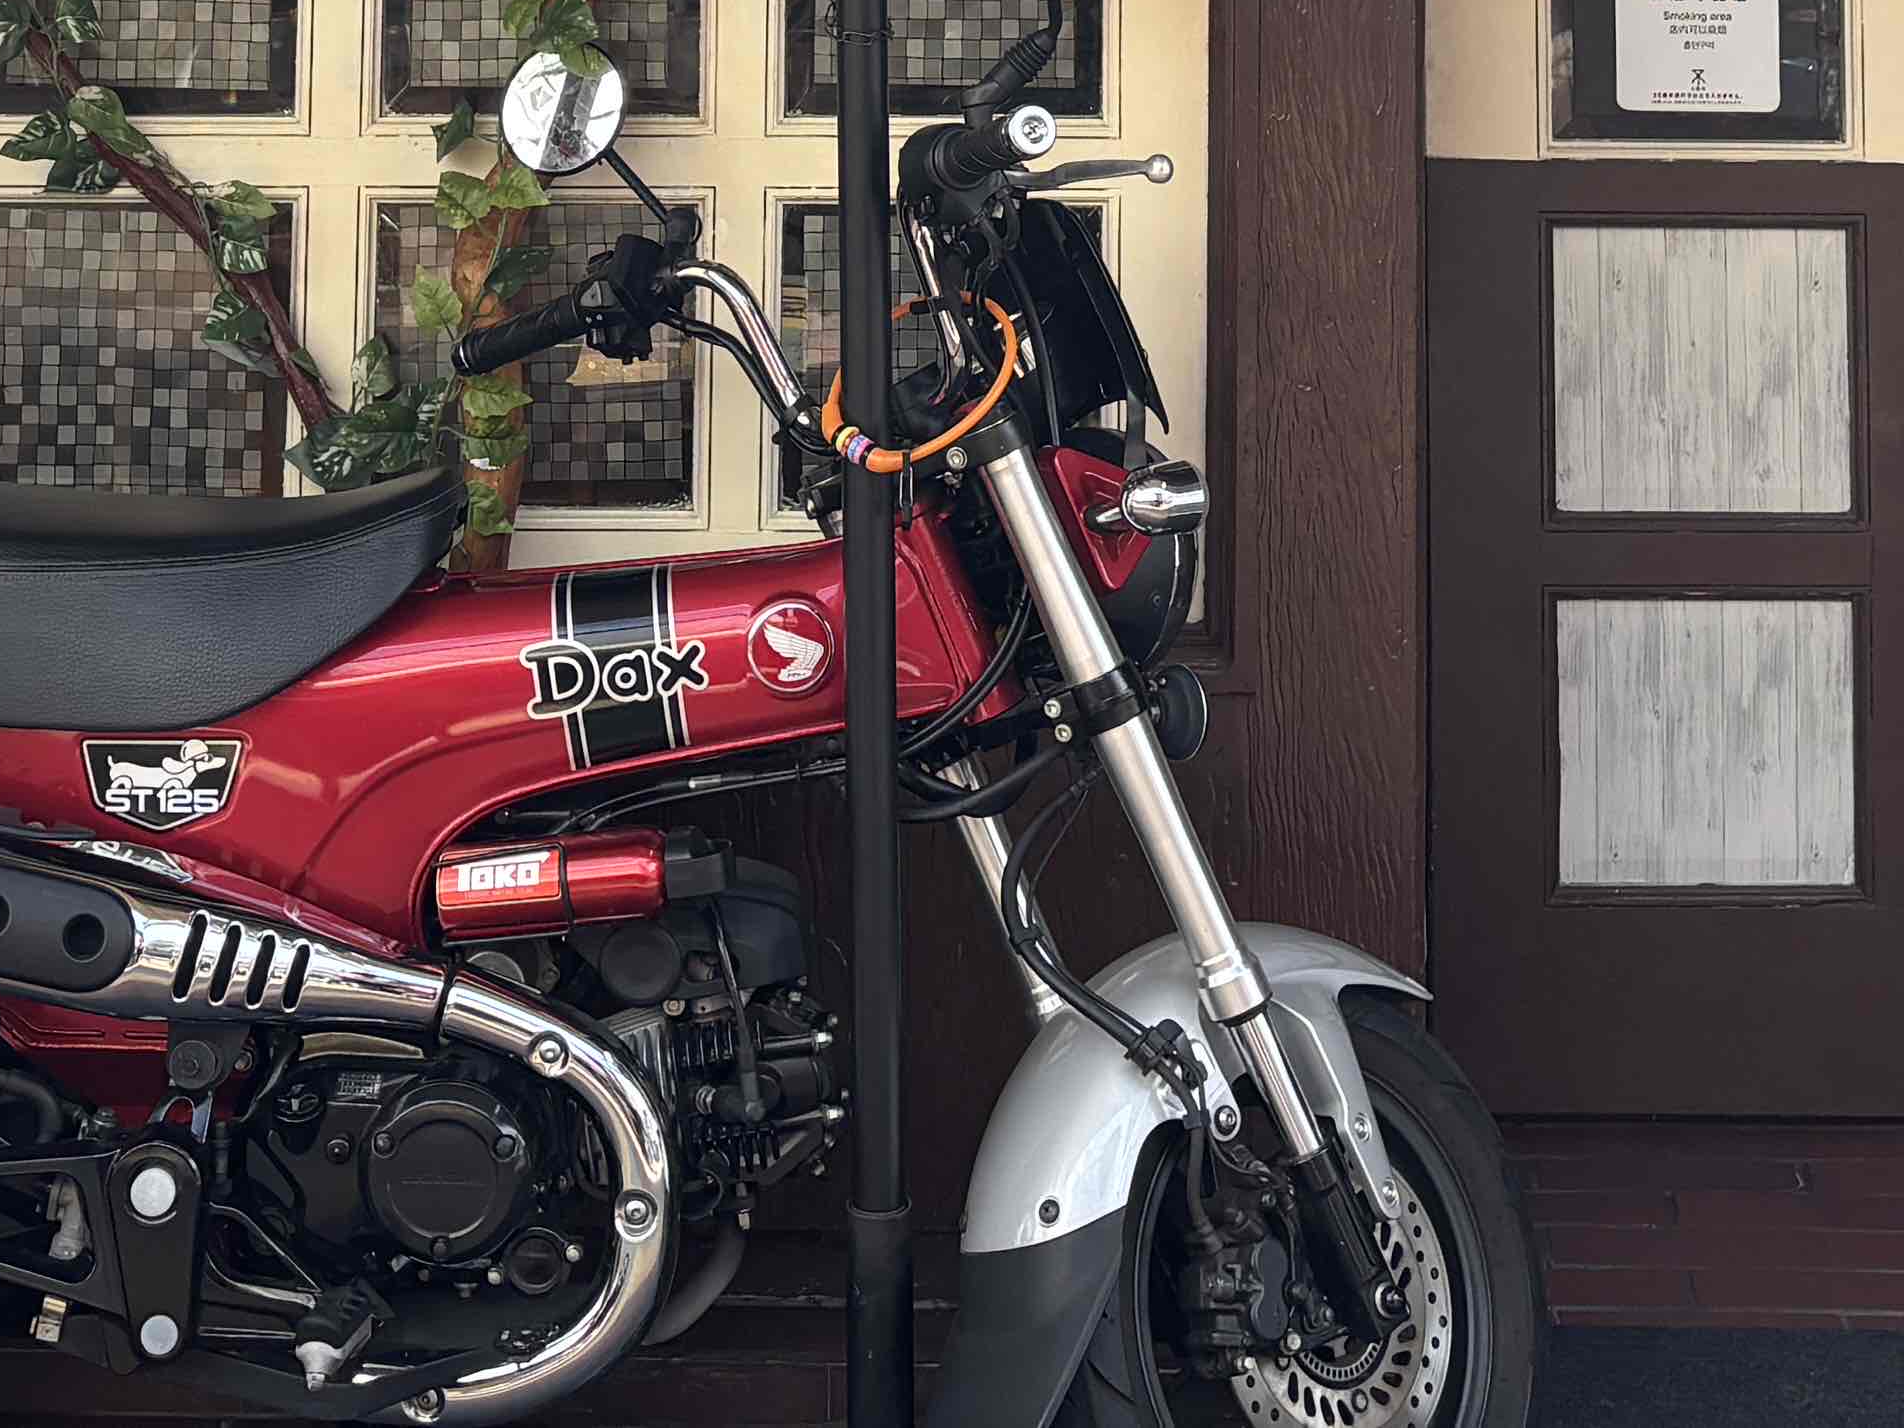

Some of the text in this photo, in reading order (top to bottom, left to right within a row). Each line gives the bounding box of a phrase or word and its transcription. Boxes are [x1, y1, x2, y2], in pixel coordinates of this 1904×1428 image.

[1664, 11, 1732, 22] Smoking area
[519, 639, 710, 720] Dax
